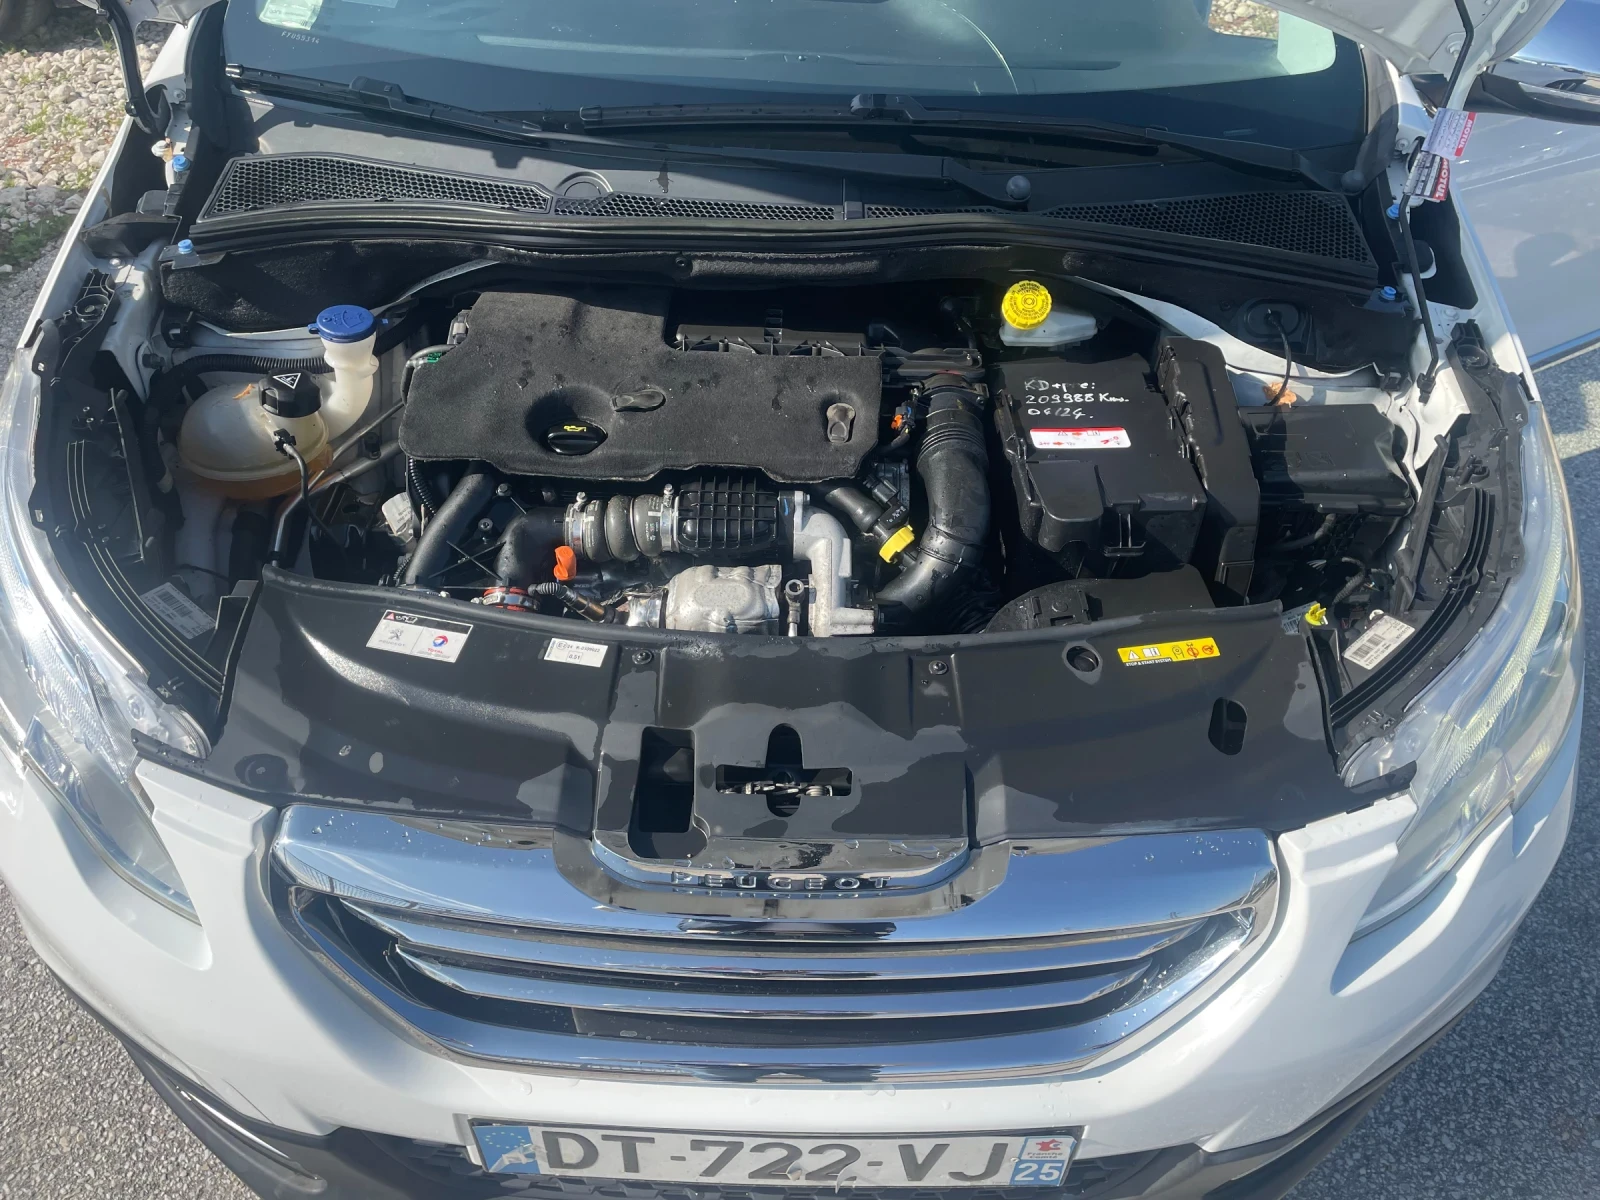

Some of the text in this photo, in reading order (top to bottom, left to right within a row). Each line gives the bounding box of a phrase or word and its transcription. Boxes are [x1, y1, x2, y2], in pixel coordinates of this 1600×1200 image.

[1457, 119, 1474, 149] MOTUL
[1435, 157, 1450, 198] MOTUL
[427, 647, 444, 655] TOTAL
[671, 870, 891, 890] PEUGEOT
[541, 1130, 1009, 1182] DT-722-VJ
[1014, 1162, 1063, 1181] 25
